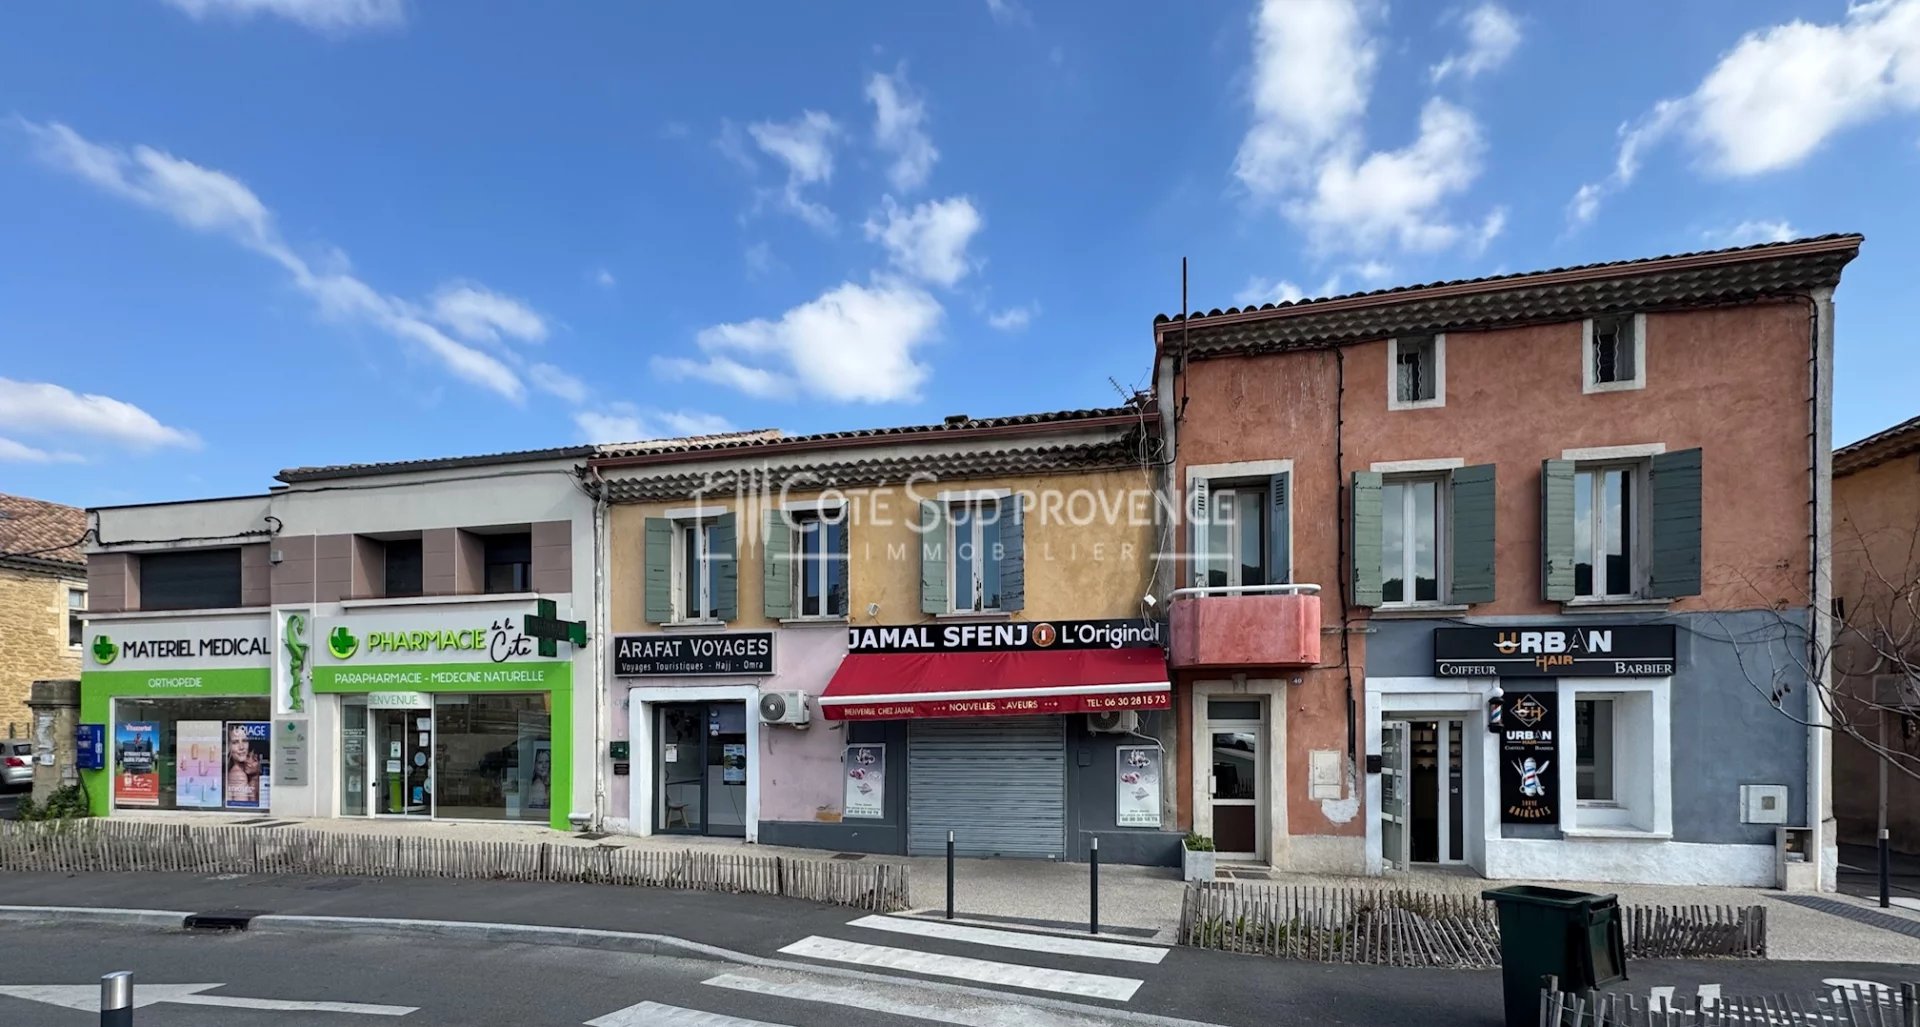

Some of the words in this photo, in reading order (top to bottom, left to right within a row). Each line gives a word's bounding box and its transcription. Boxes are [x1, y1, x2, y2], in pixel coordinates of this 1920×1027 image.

[491, 620, 502, 630] de
[367, 628, 487, 652] PHARMACIE
[849, 627, 935, 649] JAMAL
[943, 625, 1028, 647] SFENJ
[1062, 622, 1159, 649] L'Original
[1497, 628, 1612, 654] URBAN
[123, 639, 195, 658] MATERIEL
[200, 637, 271, 656] MEDICAL
[619, 640, 683, 658] ARAFAT
[690, 638, 769, 656] VOYAGES
[622, 662, 651, 672] Voyages
[656, 661, 704, 672] Touristiques
[715, 661, 731, 671] Hajj
[743, 660, 764, 670] Omra
[1440, 663, 1497, 676] COIFFEUR
[1615, 662, 1672, 674] BARBIER
[1536, 655, 1574, 672] HAIR
[148, 677, 203, 688] ORTHOPEDIE
[334, 672, 422, 684] PARAPHARMACIE
[431, 671, 482, 684] MEDECINE
[484, 671, 544, 683] NATURELLE
[949, 702, 996, 711] NOUVELLES
[1105, 698, 1116, 706] 06
[1118, 697, 1129, 706] 30
[1155, 695, 1166, 704] 73
[878, 707, 893, 715] CHEZ
[1506, 730, 1552, 740] URBAN
